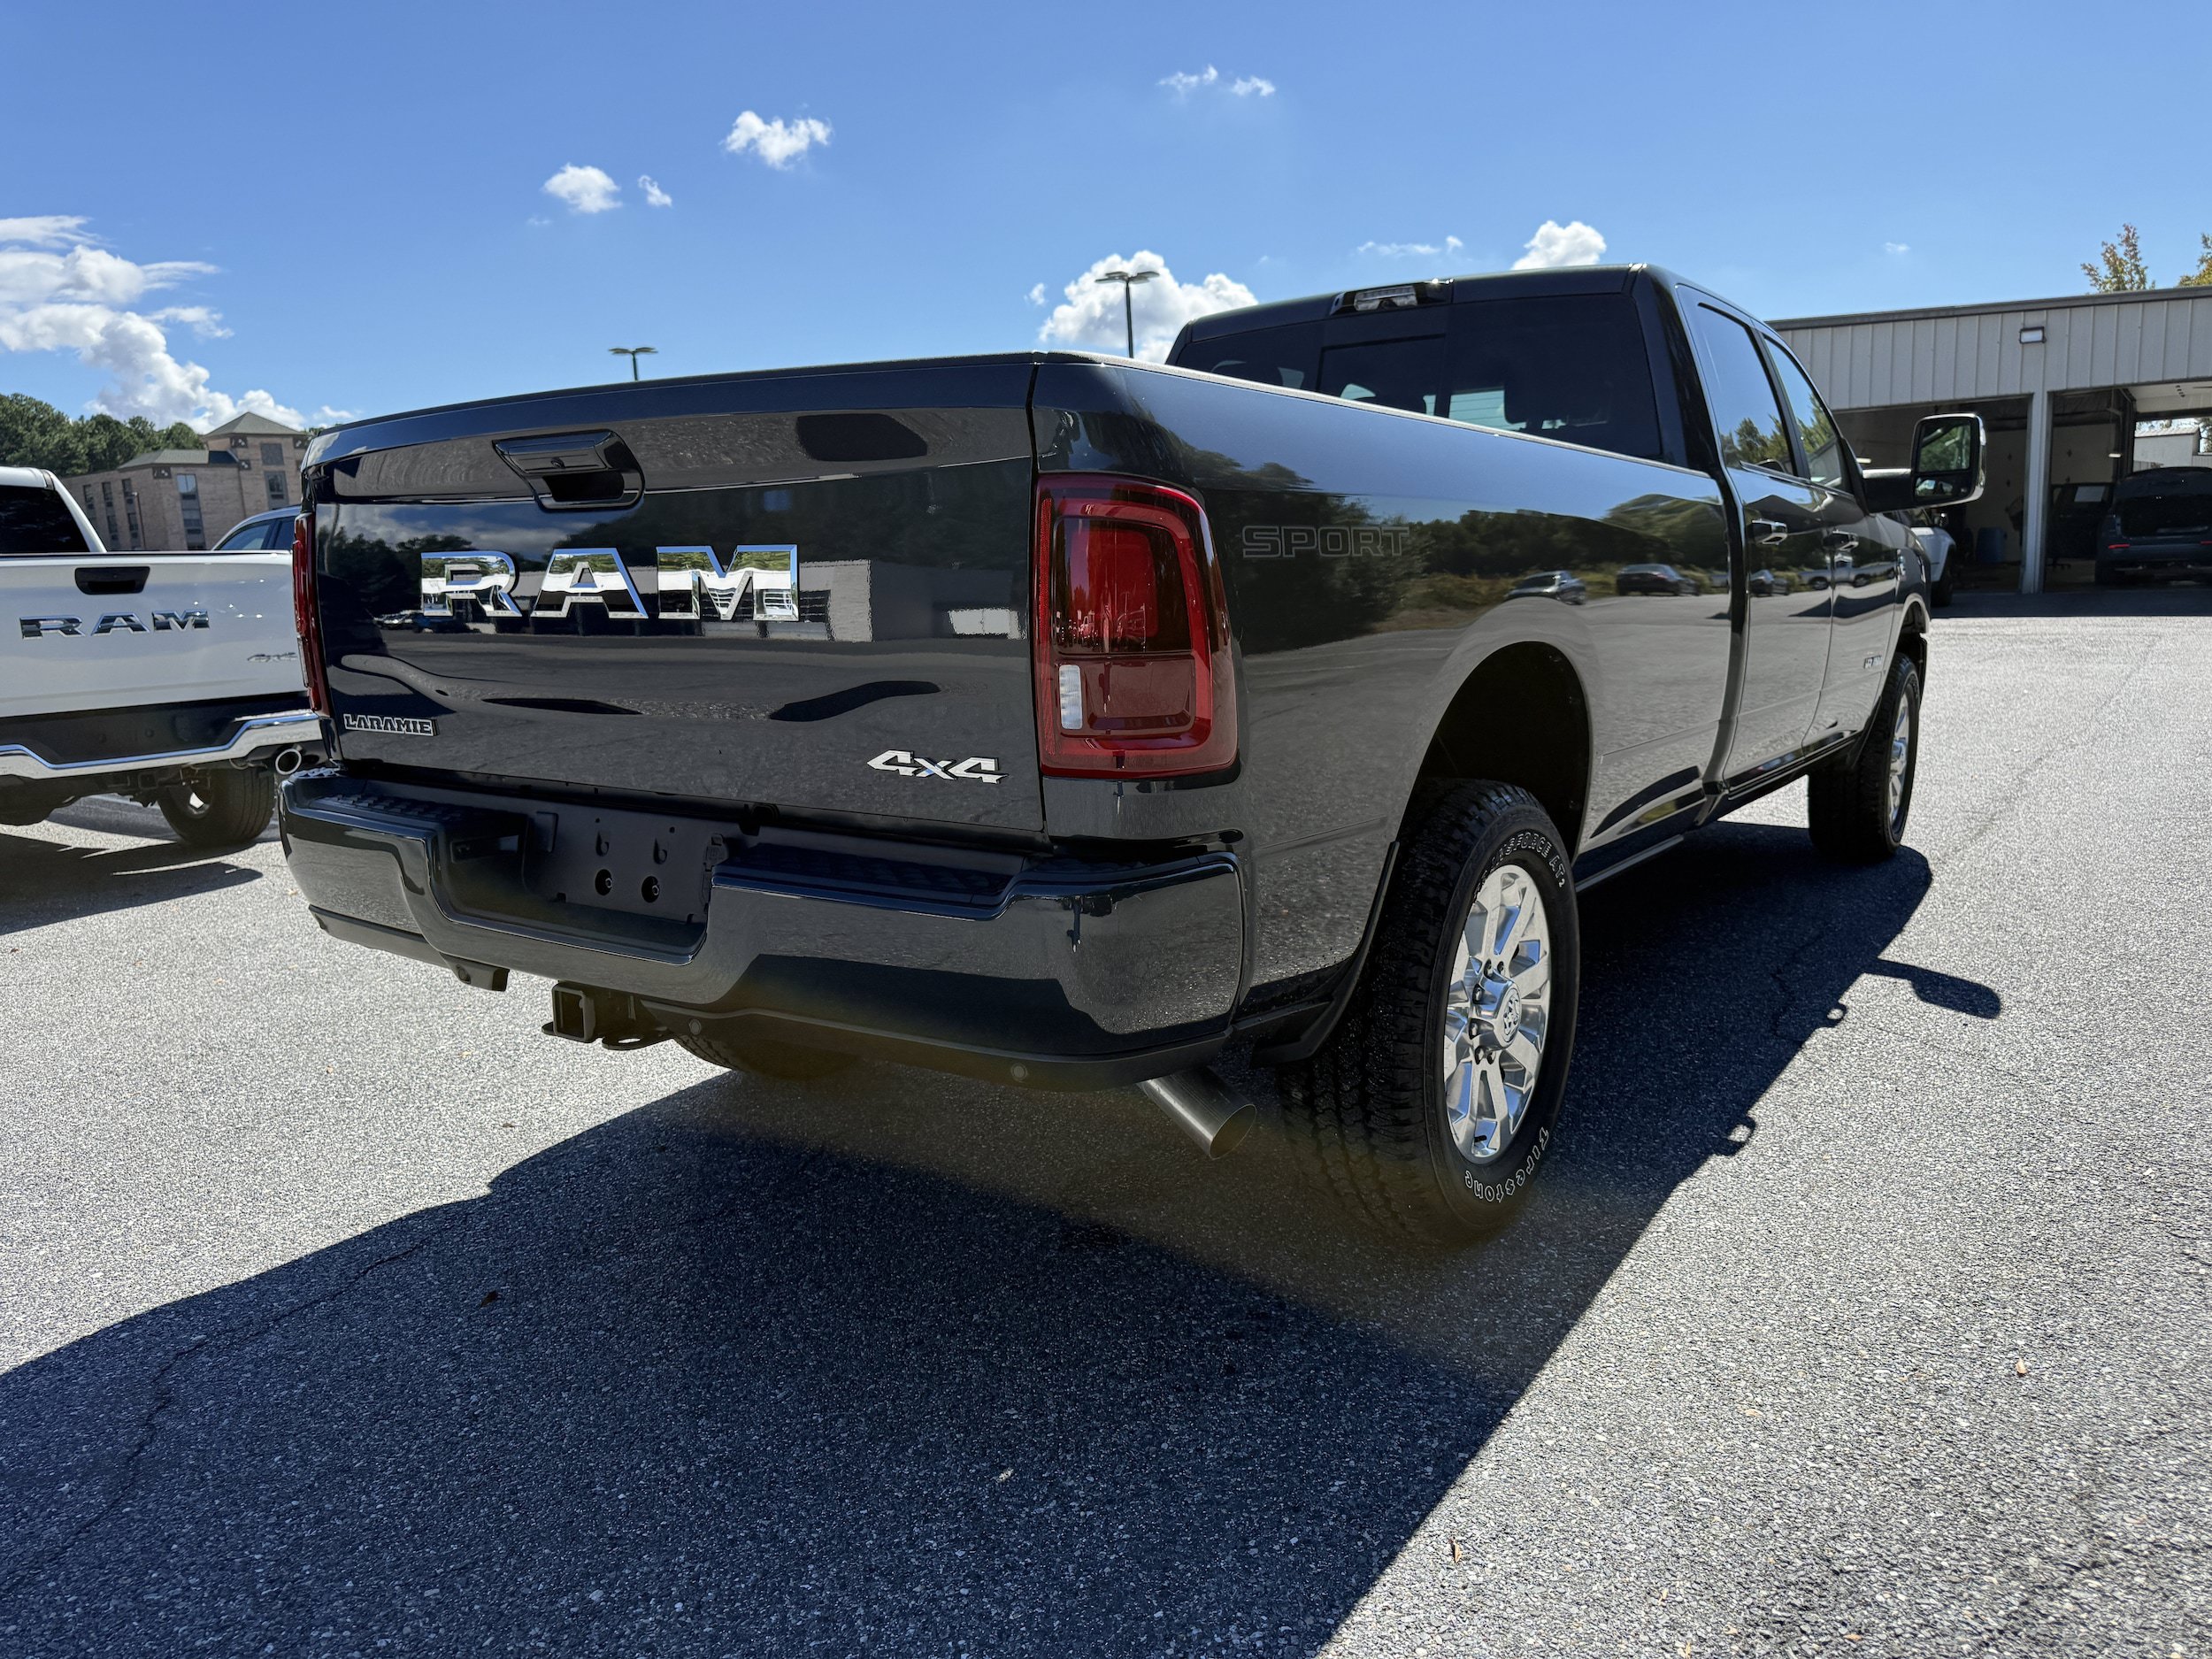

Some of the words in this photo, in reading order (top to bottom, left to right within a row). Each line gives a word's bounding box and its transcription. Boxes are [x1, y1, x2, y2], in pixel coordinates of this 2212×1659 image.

[1241, 525, 1410, 558] SPORT
[420, 544, 800, 622] RAM
[19, 609, 211, 640] RAM
[342, 713, 436, 736] LARAMIE
[1464, 1126, 1549, 1203] Firestone
